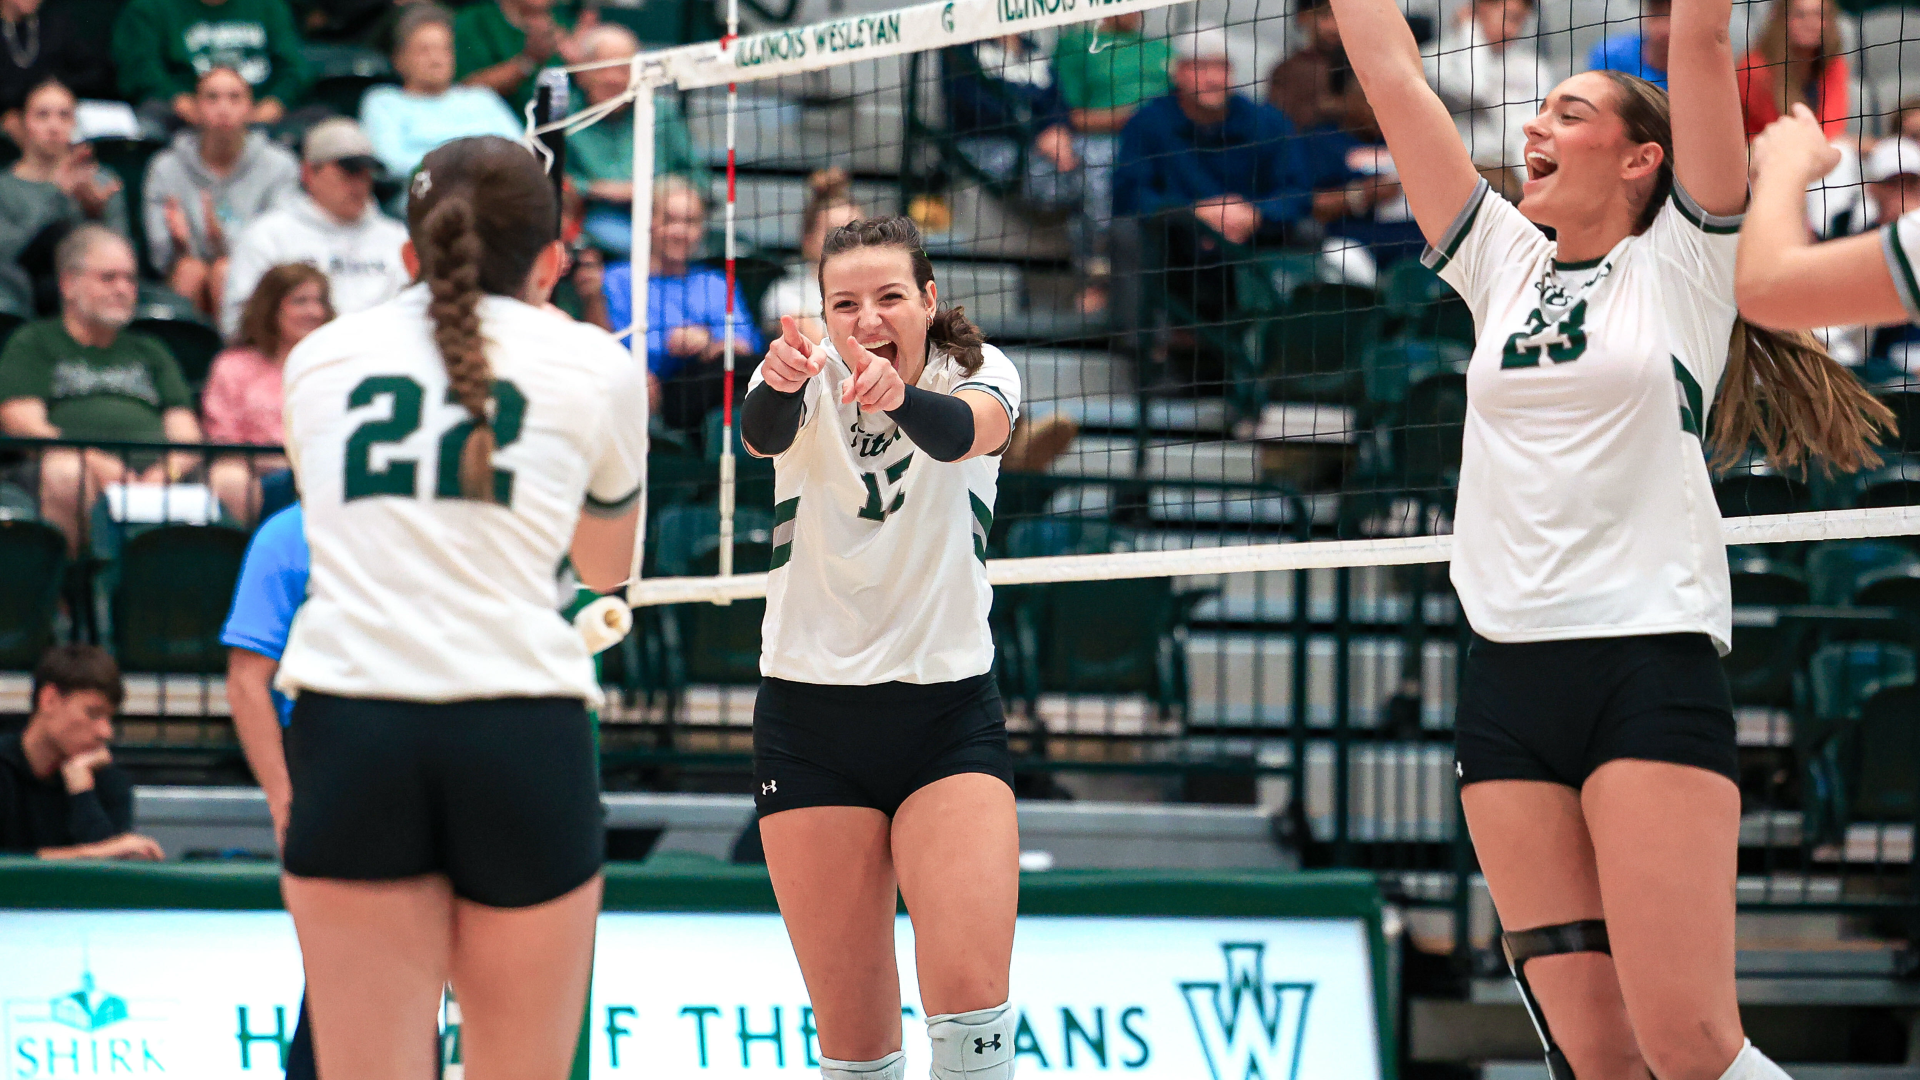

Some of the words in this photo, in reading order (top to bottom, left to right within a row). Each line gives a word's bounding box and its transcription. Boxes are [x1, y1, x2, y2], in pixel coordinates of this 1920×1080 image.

[735, 28, 806, 68] ILLINOIS
[813, 12, 901, 53] WESLEYAN
[1500, 298, 1588, 370] 23
[342, 373, 529, 509] 22
[15, 1036, 166, 1079] SHIRK
